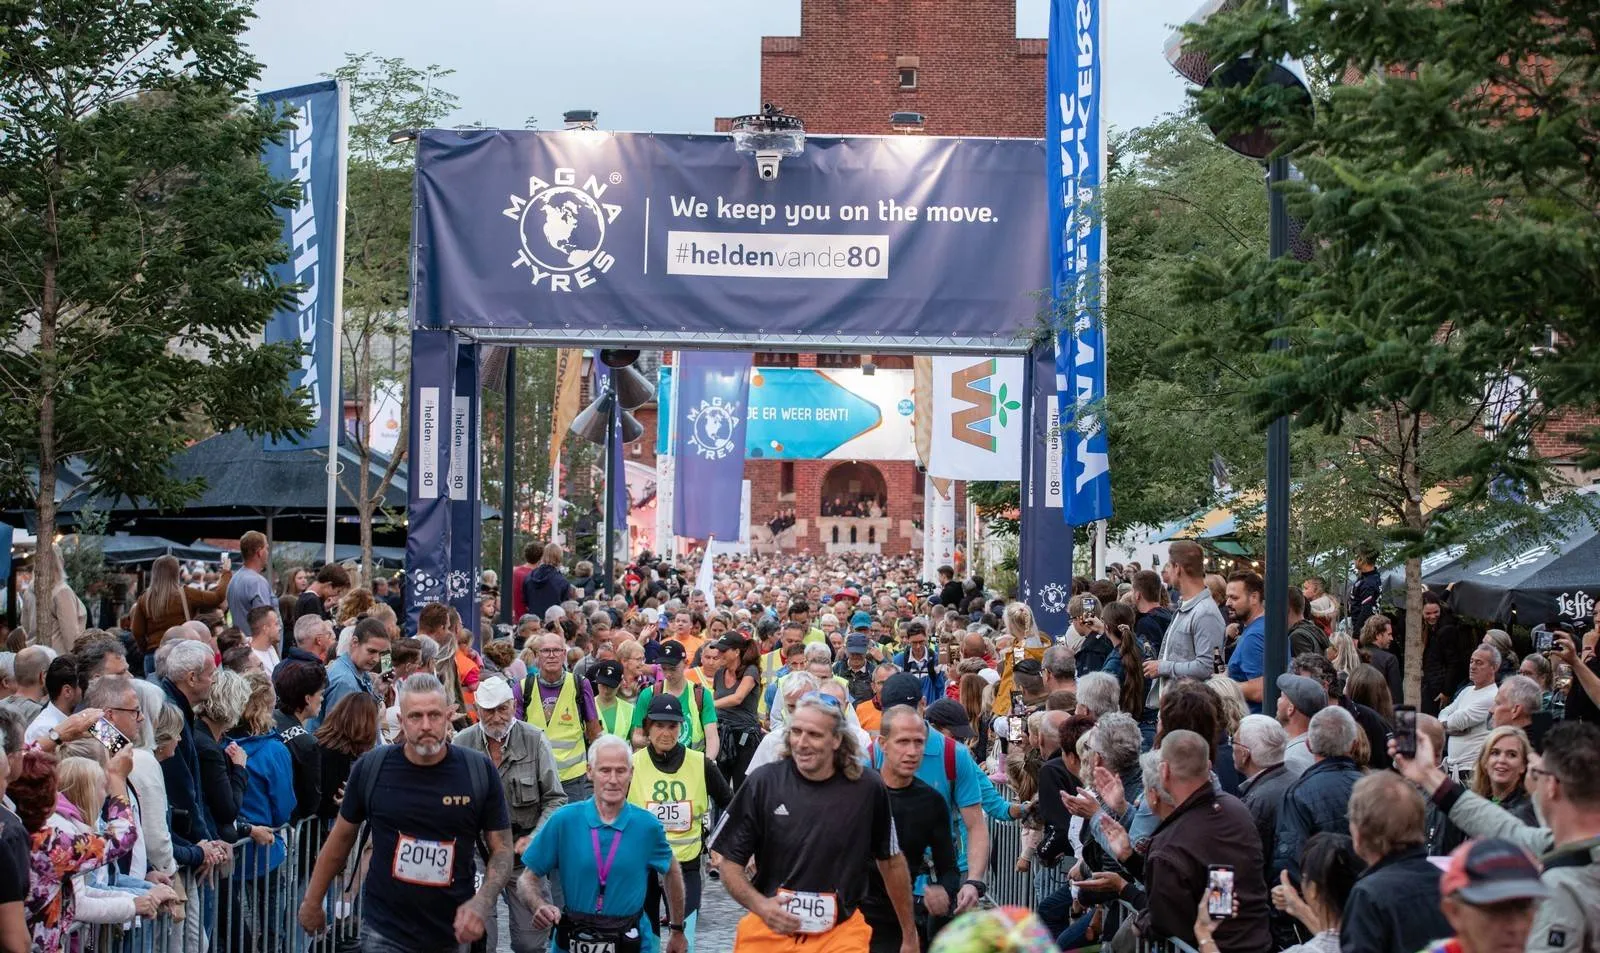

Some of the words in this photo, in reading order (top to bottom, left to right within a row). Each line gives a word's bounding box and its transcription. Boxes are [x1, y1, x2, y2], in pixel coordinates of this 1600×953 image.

[502, 168, 622, 224] MAGNA
[670, 195, 708, 218] We
[717, 196, 776, 225] keep
[785, 204, 831, 226] you
[839, 205, 869, 221] on
[878, 199, 917, 221] the
[927, 205, 999, 223] move.
[676, 242, 881, 268] #heldenvande80
[511, 249, 616, 292] TYRES
[687, 396, 740, 428] MAGNA
[762, 407, 777, 420] ER
[780, 407, 812, 421] WEER
[815, 408, 849, 421] BENT!
[687, 435, 735, 460] TYRES
[1556, 590, 1595, 620] Leffe
[442, 795, 471, 806] OTP
[652, 780, 686, 802] 80
[657, 805, 680, 820] 215
[400, 843, 448, 867] 2043
